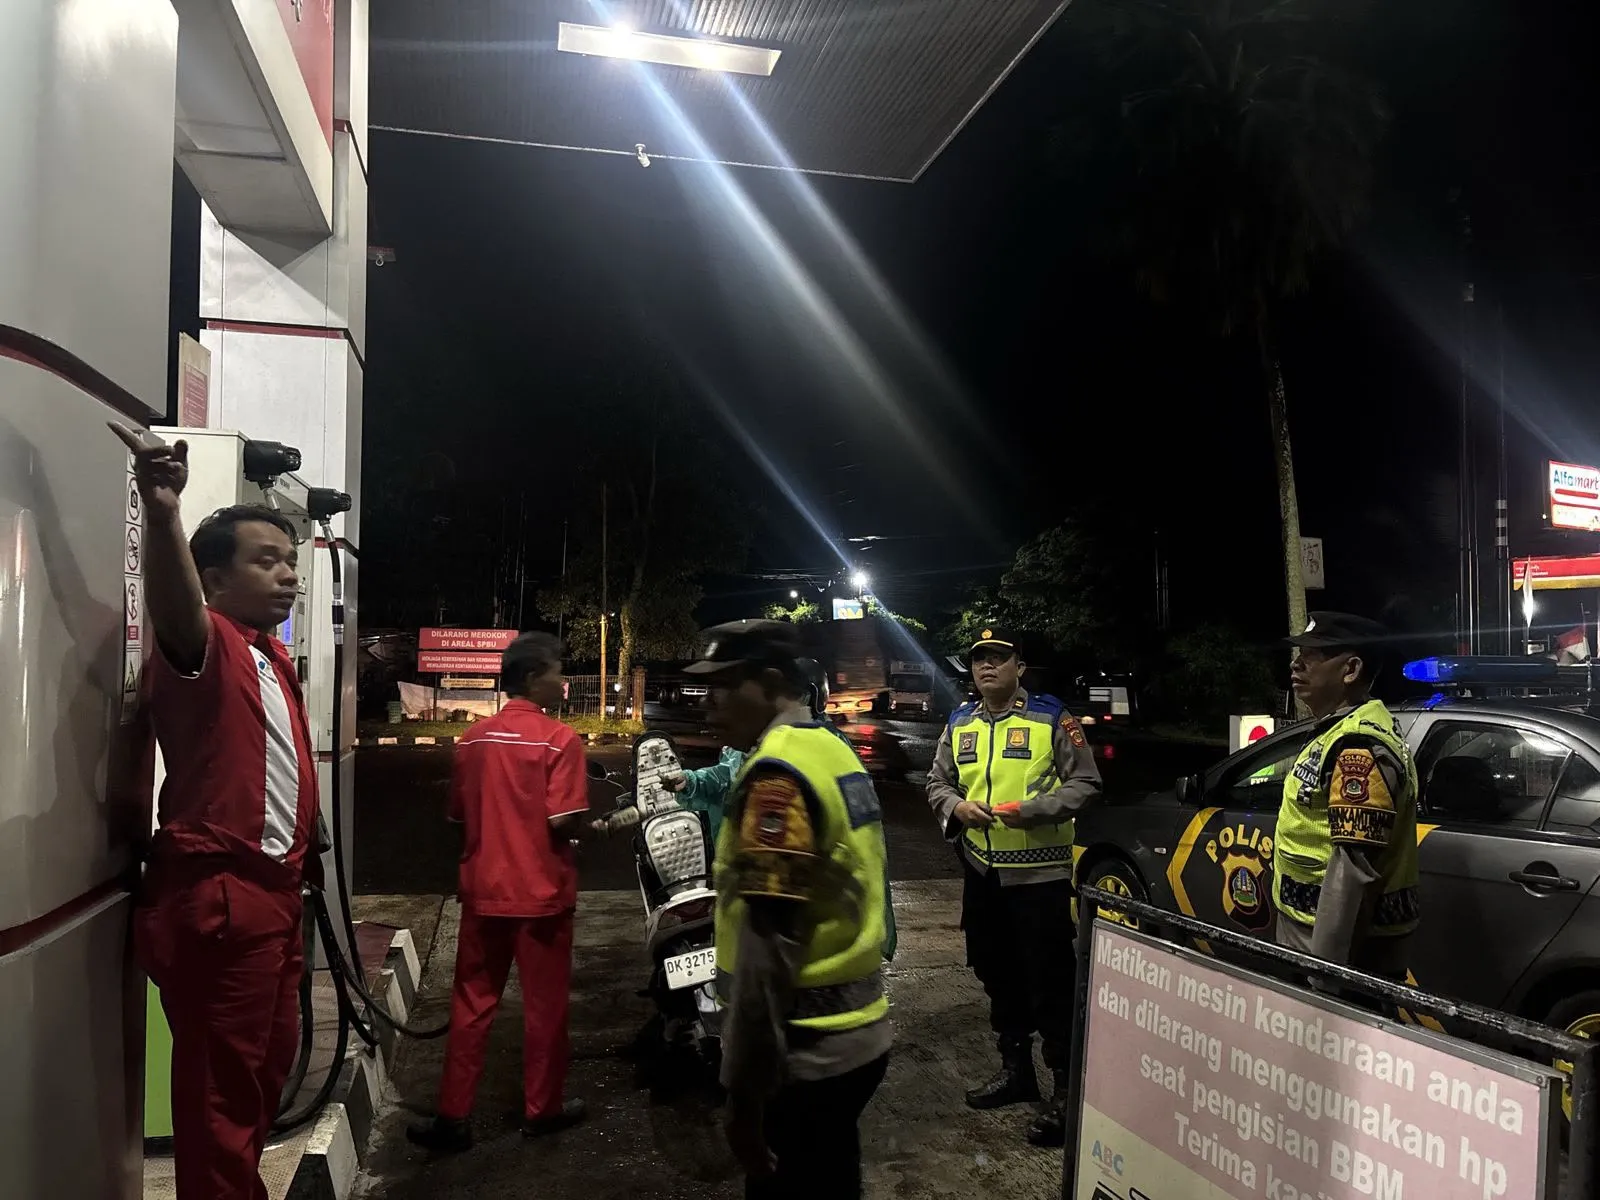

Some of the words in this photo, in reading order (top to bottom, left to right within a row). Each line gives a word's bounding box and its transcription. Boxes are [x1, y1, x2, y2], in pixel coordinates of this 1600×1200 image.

[1553, 469, 1599, 490] Alfamart
[431, 630, 469, 638] DILARANG
[470, 631, 508, 639] MEROKOK
[441, 639, 449, 647] DI
[477, 640, 497, 648] SPBU
[1339, 754, 1372, 764] POLRES
[1205, 824, 1274, 871] POLIS
[666, 959, 683, 974] DK
[684, 950, 715, 969] 3275
[1098, 934, 1171, 992] Matikan
[1177, 973, 1248, 1024] mesin
[1254, 995, 1415, 1092] kendaraan
[1427, 1070, 1524, 1135] anda
[1098, 982, 1130, 1021] dan
[1135, 999, 1222, 1073] dilarang
[1230, 1046, 1446, 1169] menggunakan
[1459, 1135, 1508, 1200] hp
[1140, 1053, 1187, 1098] saat
[1192, 1079, 1319, 1169] pengisian
[1330, 1139, 1404, 1200] BBM
[1091, 1139, 1125, 1177] ABC
[1174, 1111, 1257, 1190] Terima
